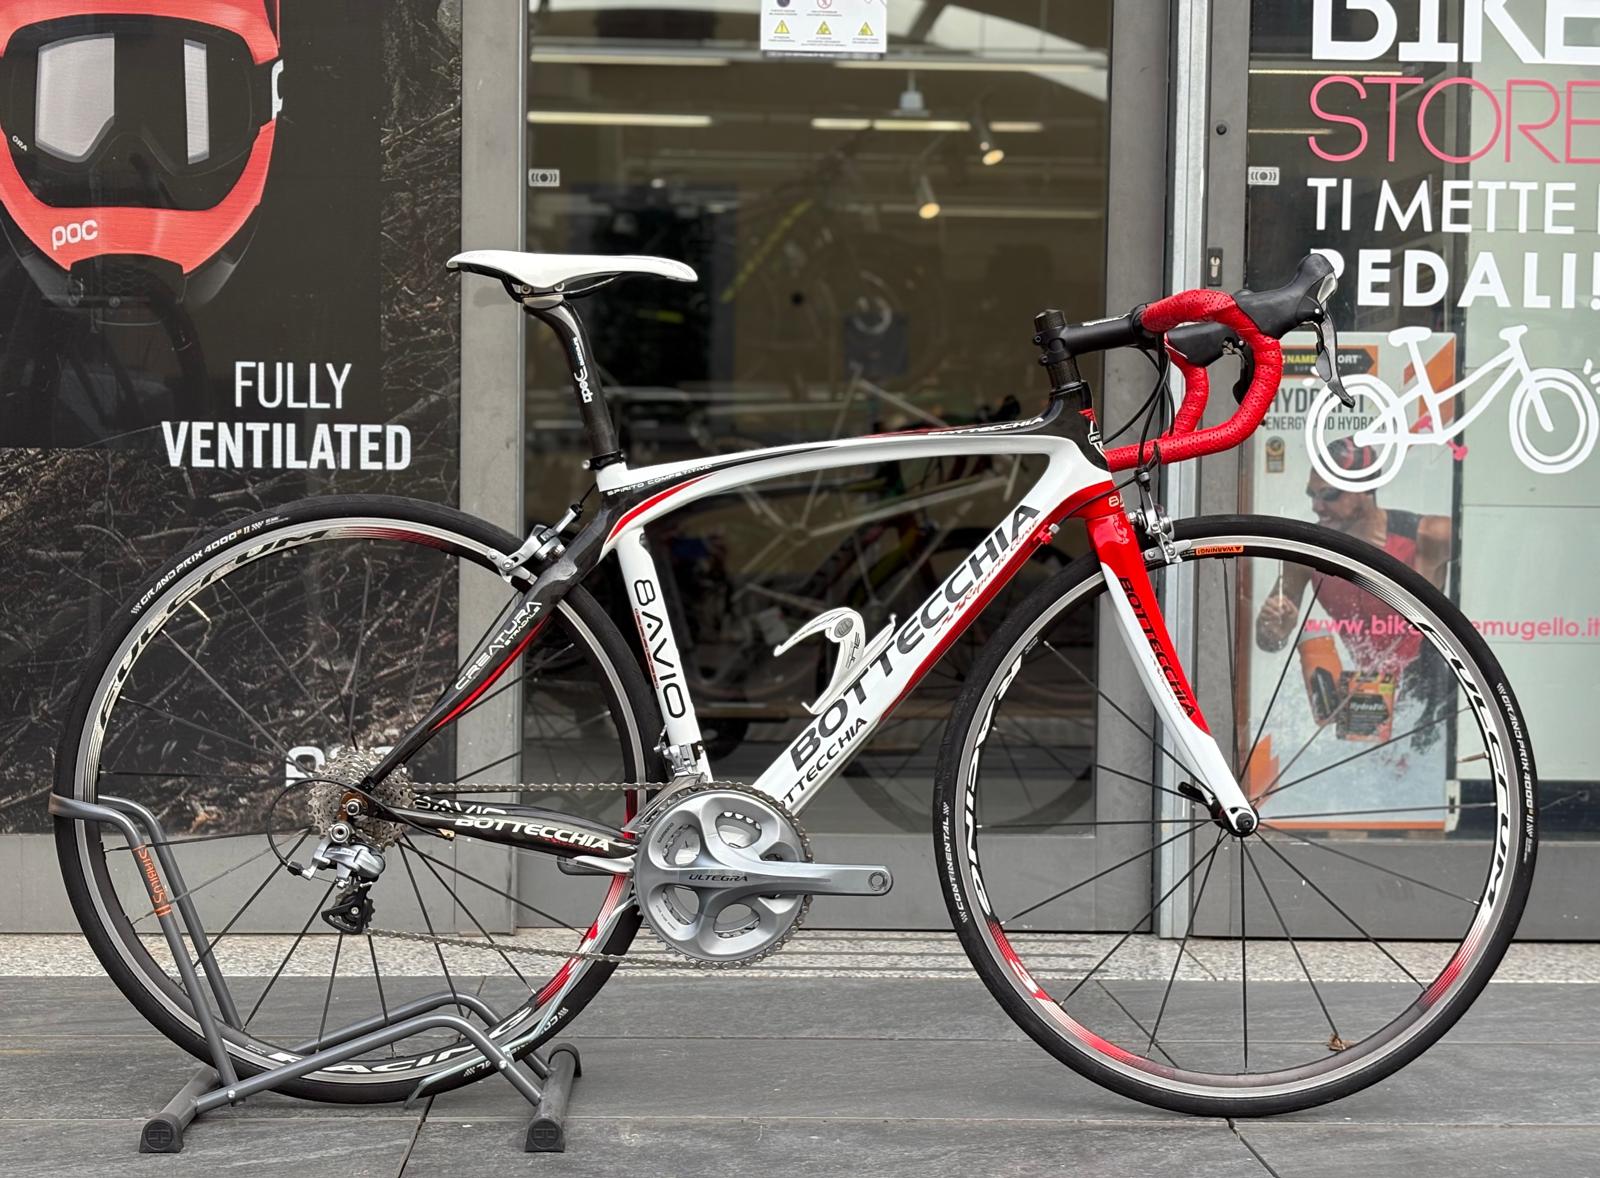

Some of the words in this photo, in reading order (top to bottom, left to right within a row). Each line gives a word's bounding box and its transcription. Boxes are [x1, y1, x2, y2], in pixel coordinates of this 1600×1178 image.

[12, 135, 28, 151] ORA
[1308, 75, 1600, 164] STORE
[1307, 178, 1352, 231] TI
[1374, 179, 1576, 235] METTE
[234, 361, 352, 409] FULLY
[161, 421, 412, 471] VENTILATED
[140, 570, 177, 607] GRAND
[176, 549, 204, 576] PRIX
[455, 601, 542, 690] CREATURA
[789, 504, 1040, 773] BOTTECCHIA
[1119, 577, 1196, 718] BOTTECCHIA
[781, 717, 868, 807] TTECCHIA
[454, 814, 610, 852] BOTTECCHIA
[688, 873, 749, 882] ULTEGRA
[942, 816, 966, 914] CONTINENTAL
